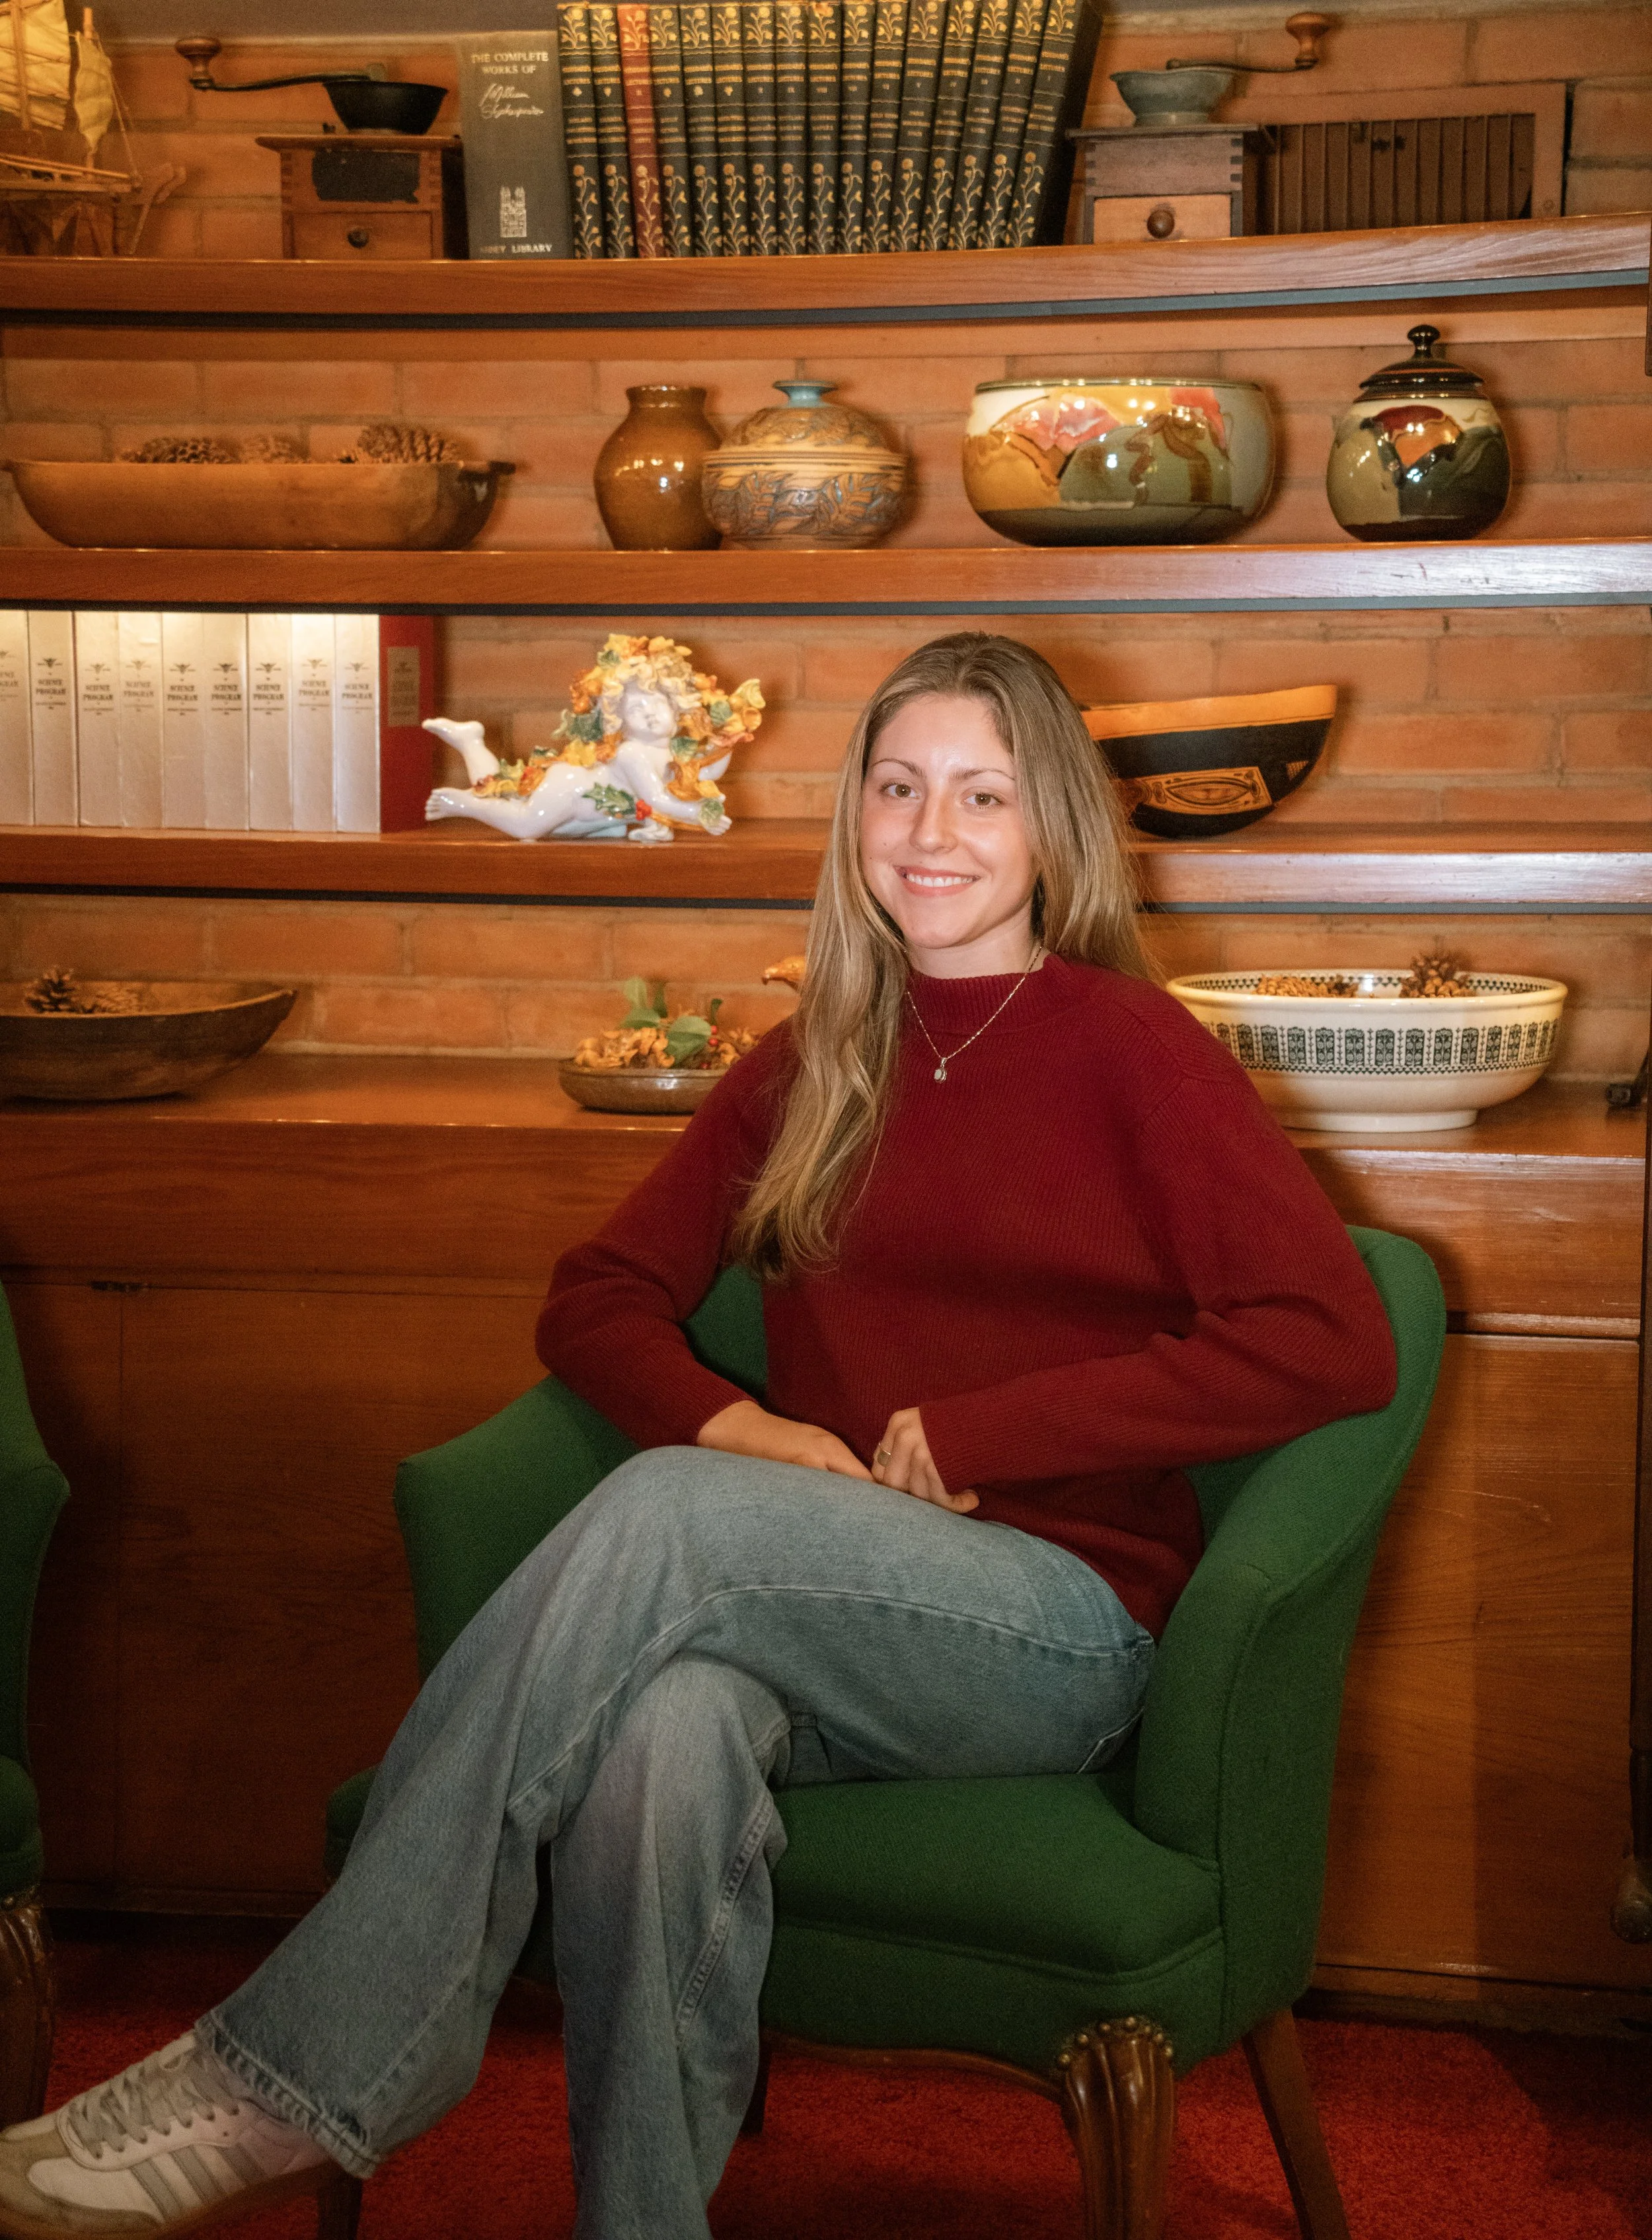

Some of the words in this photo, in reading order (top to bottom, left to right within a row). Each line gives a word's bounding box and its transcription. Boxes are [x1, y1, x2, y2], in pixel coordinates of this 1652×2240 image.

[471, 54, 490, 63] THE
[494, 52, 549, 62] COMPLETE
[482, 65, 518, 75] WORKS
[521, 64, 536, 74] OF
[511, 243, 553, 253] LIBRARY
